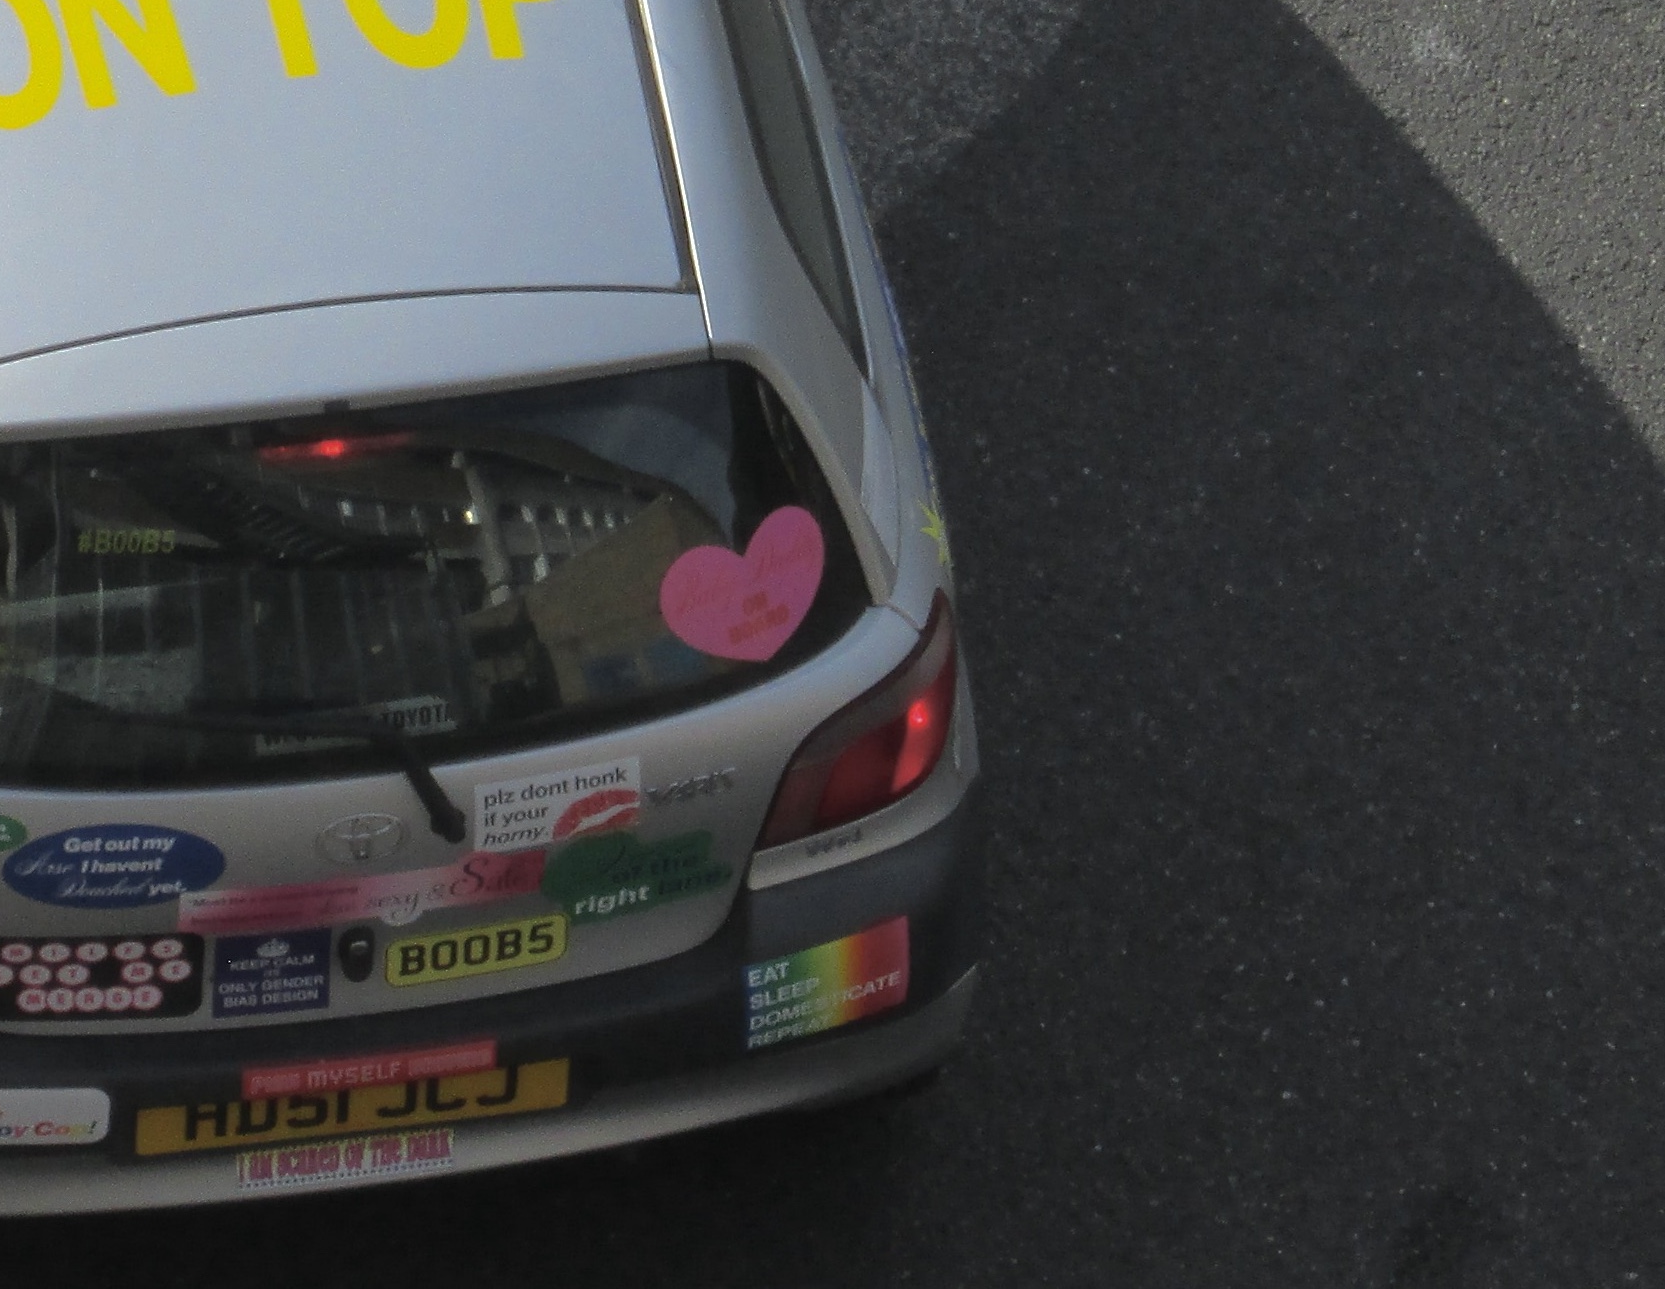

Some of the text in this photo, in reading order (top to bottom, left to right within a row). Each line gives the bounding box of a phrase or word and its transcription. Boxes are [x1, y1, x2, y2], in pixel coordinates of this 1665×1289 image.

[380, 702, 451, 730] TOYOT
[483, 788, 515, 811] plz
[519, 778, 569, 803] dont
[573, 767, 629, 792] honk
[483, 806, 549, 828] if your
[63, 835, 177, 854] Get out my
[483, 826, 551, 846] horny.
[91, 859, 163, 874] havent
[147, 879, 187, 896] yet.
[574, 883, 651, 916] right
[230, 954, 315, 972] KEEP CALM
[747, 961, 790, 988] EAT
[218, 975, 324, 994] ONLY GENDER
[748, 976, 820, 1011] SLEEP
[223, 988, 319, 1009] BIAS DESIGN
[749, 970, 902, 1031] DOMESTICATE
[747, 1014, 831, 1050] REPEAT
[306, 1061, 402, 1088] MYSELF
